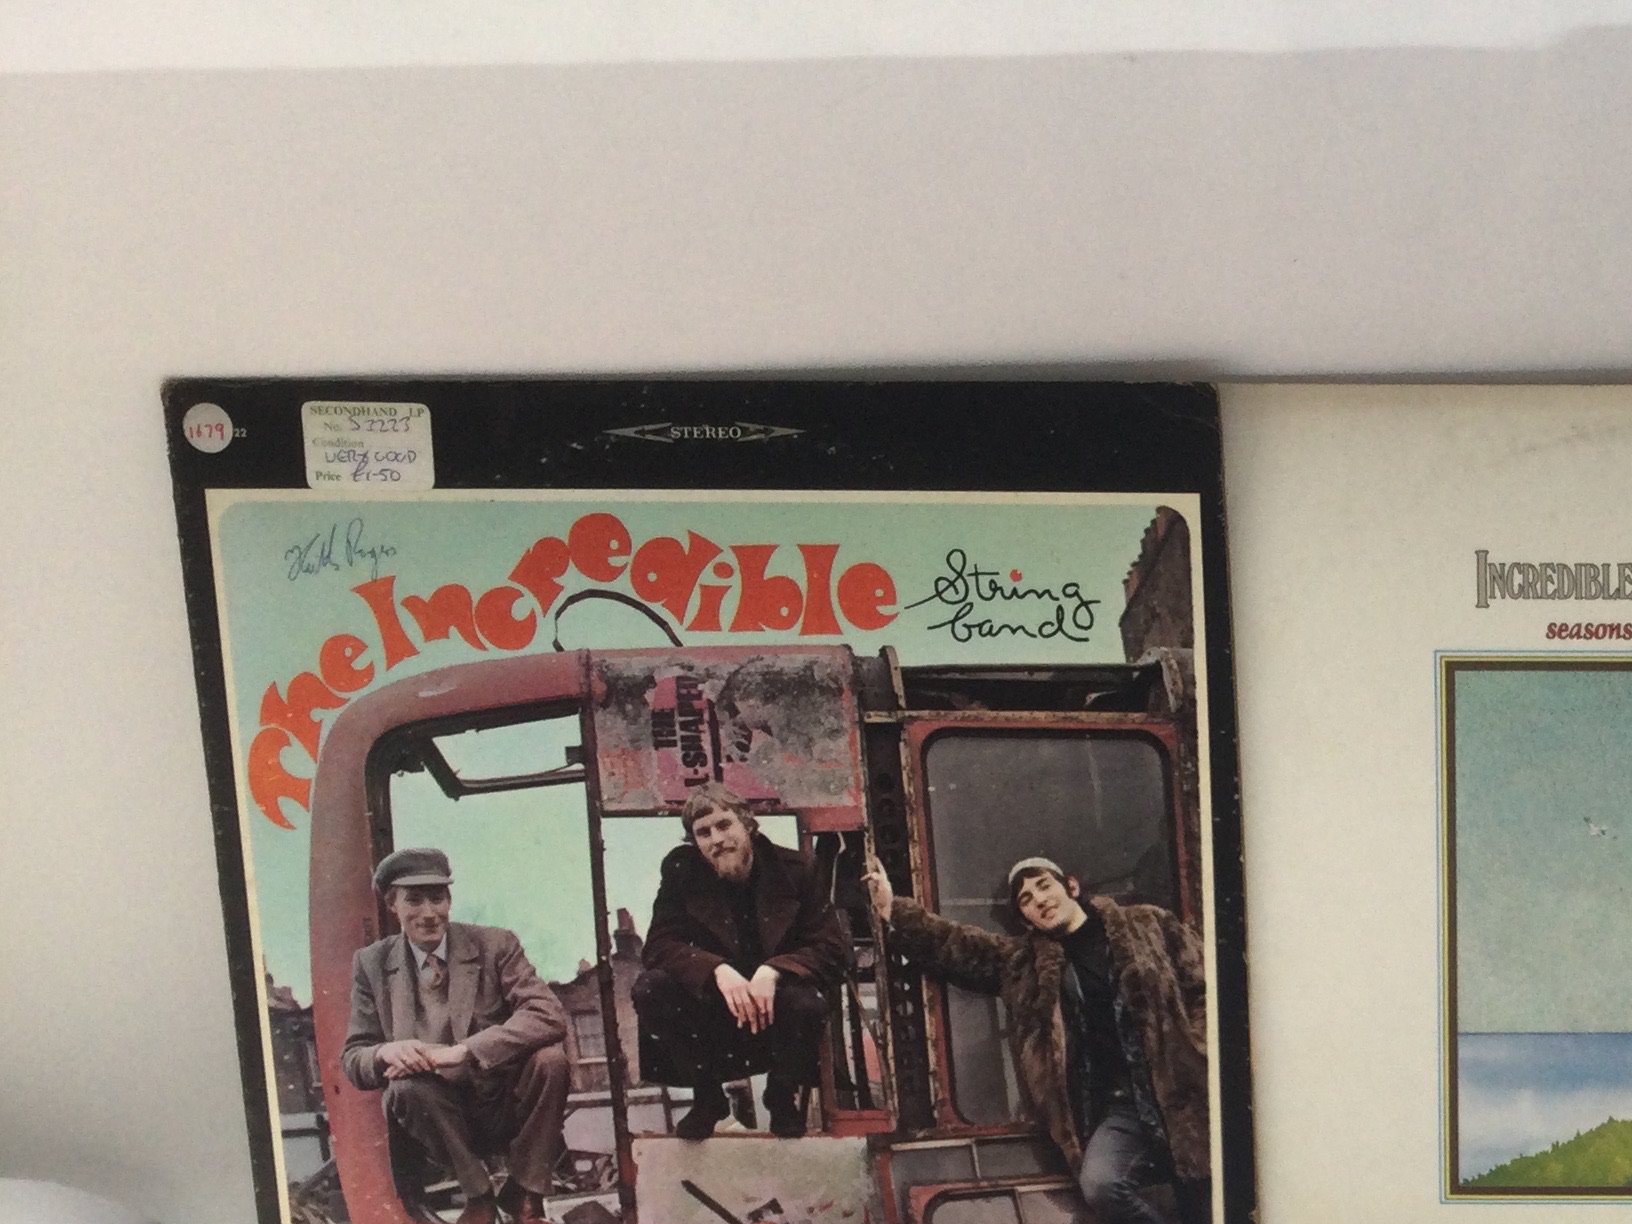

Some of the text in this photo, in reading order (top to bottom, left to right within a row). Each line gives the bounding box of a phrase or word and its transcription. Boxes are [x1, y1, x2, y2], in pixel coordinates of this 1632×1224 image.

[310, 405, 397, 417] SECONDHAND
[670, 425, 742, 440] STEREO
[312, 438, 364, 448] Condition
[315, 471, 342, 481] Price
[905, 548, 1100, 631] String
[928, 604, 1090, 643] band
[247, 512, 899, 831] The Incredible
